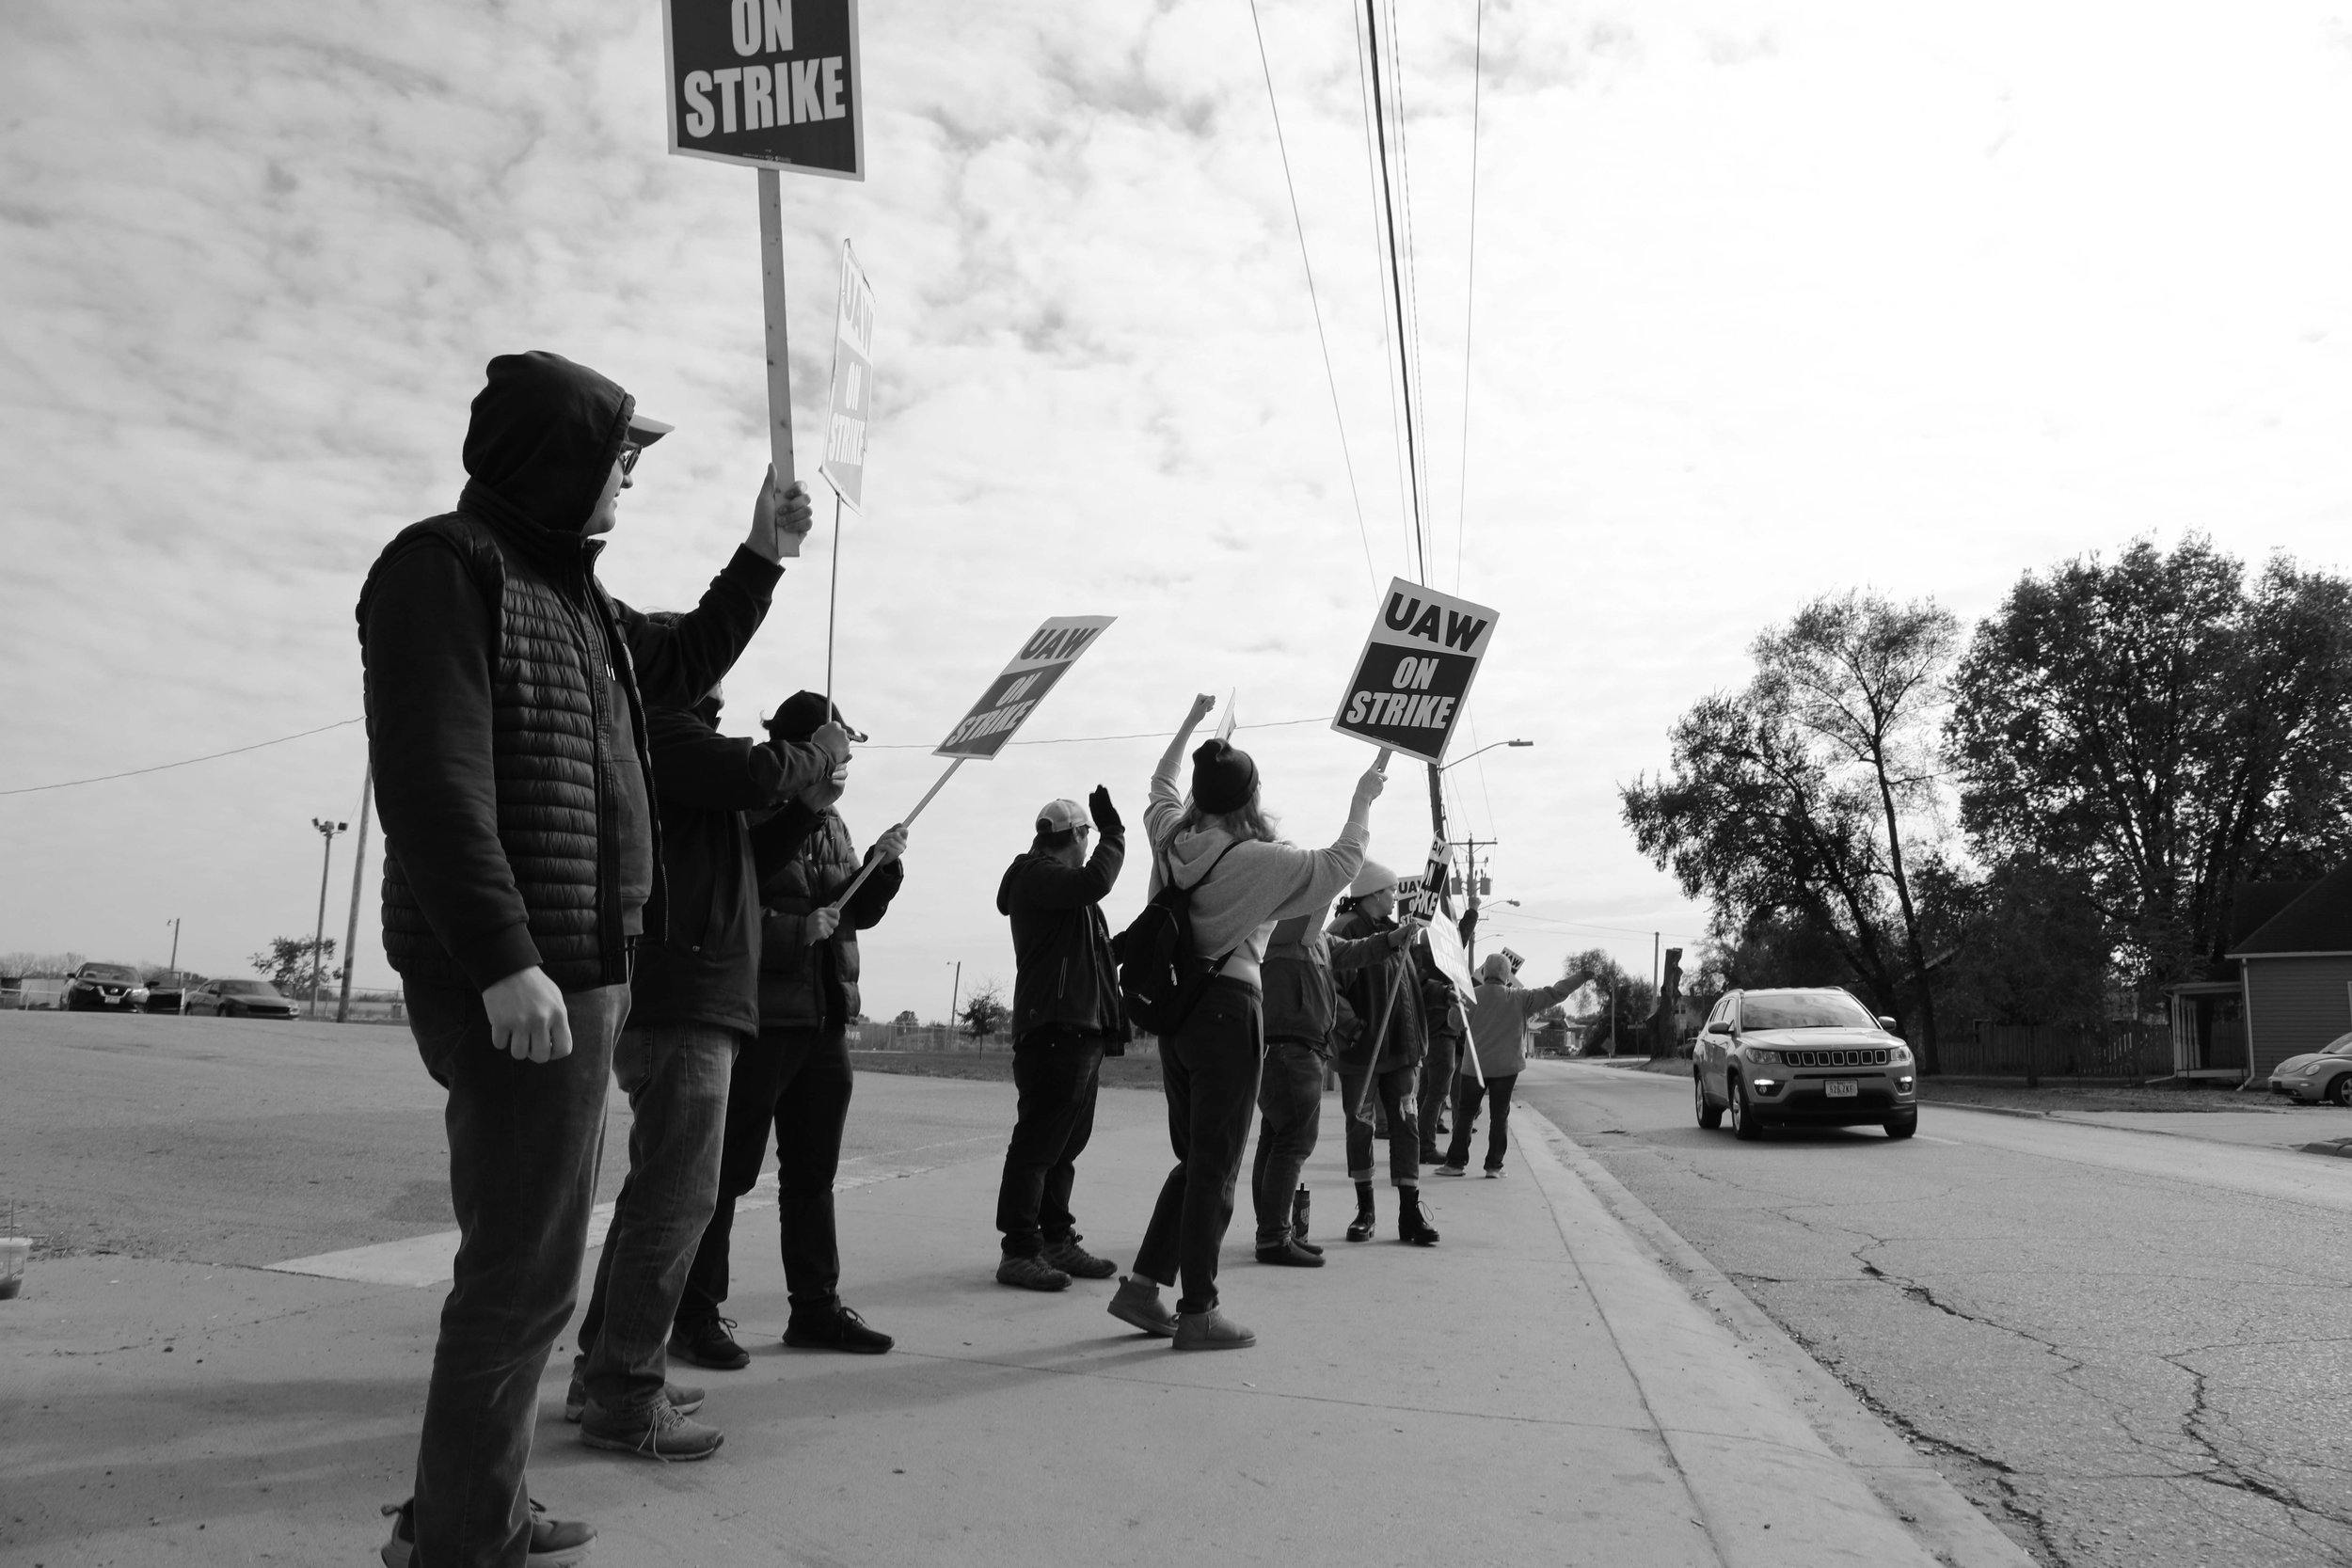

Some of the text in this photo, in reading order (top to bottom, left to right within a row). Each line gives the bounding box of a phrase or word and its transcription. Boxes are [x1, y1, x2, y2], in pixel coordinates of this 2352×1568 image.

[732, 0, 793, 56] ON
[684, 55, 846, 138] STRIKE
[842, 261, 873, 356] UAW
[846, 361, 862, 411] ON
[828, 412, 865, 466] STRIKE
[1020, 627, 1100, 659] UAW
[1385, 592, 1488, 652] UAW
[995, 671, 1043, 706] ON
[1392, 657, 1438, 689] ON
[946, 699, 1037, 747] STRIKE
[1346, 690, 1455, 729] STRIKE
[1432, 841, 1444, 857] AW
[1399, 880, 1421, 894] UA
